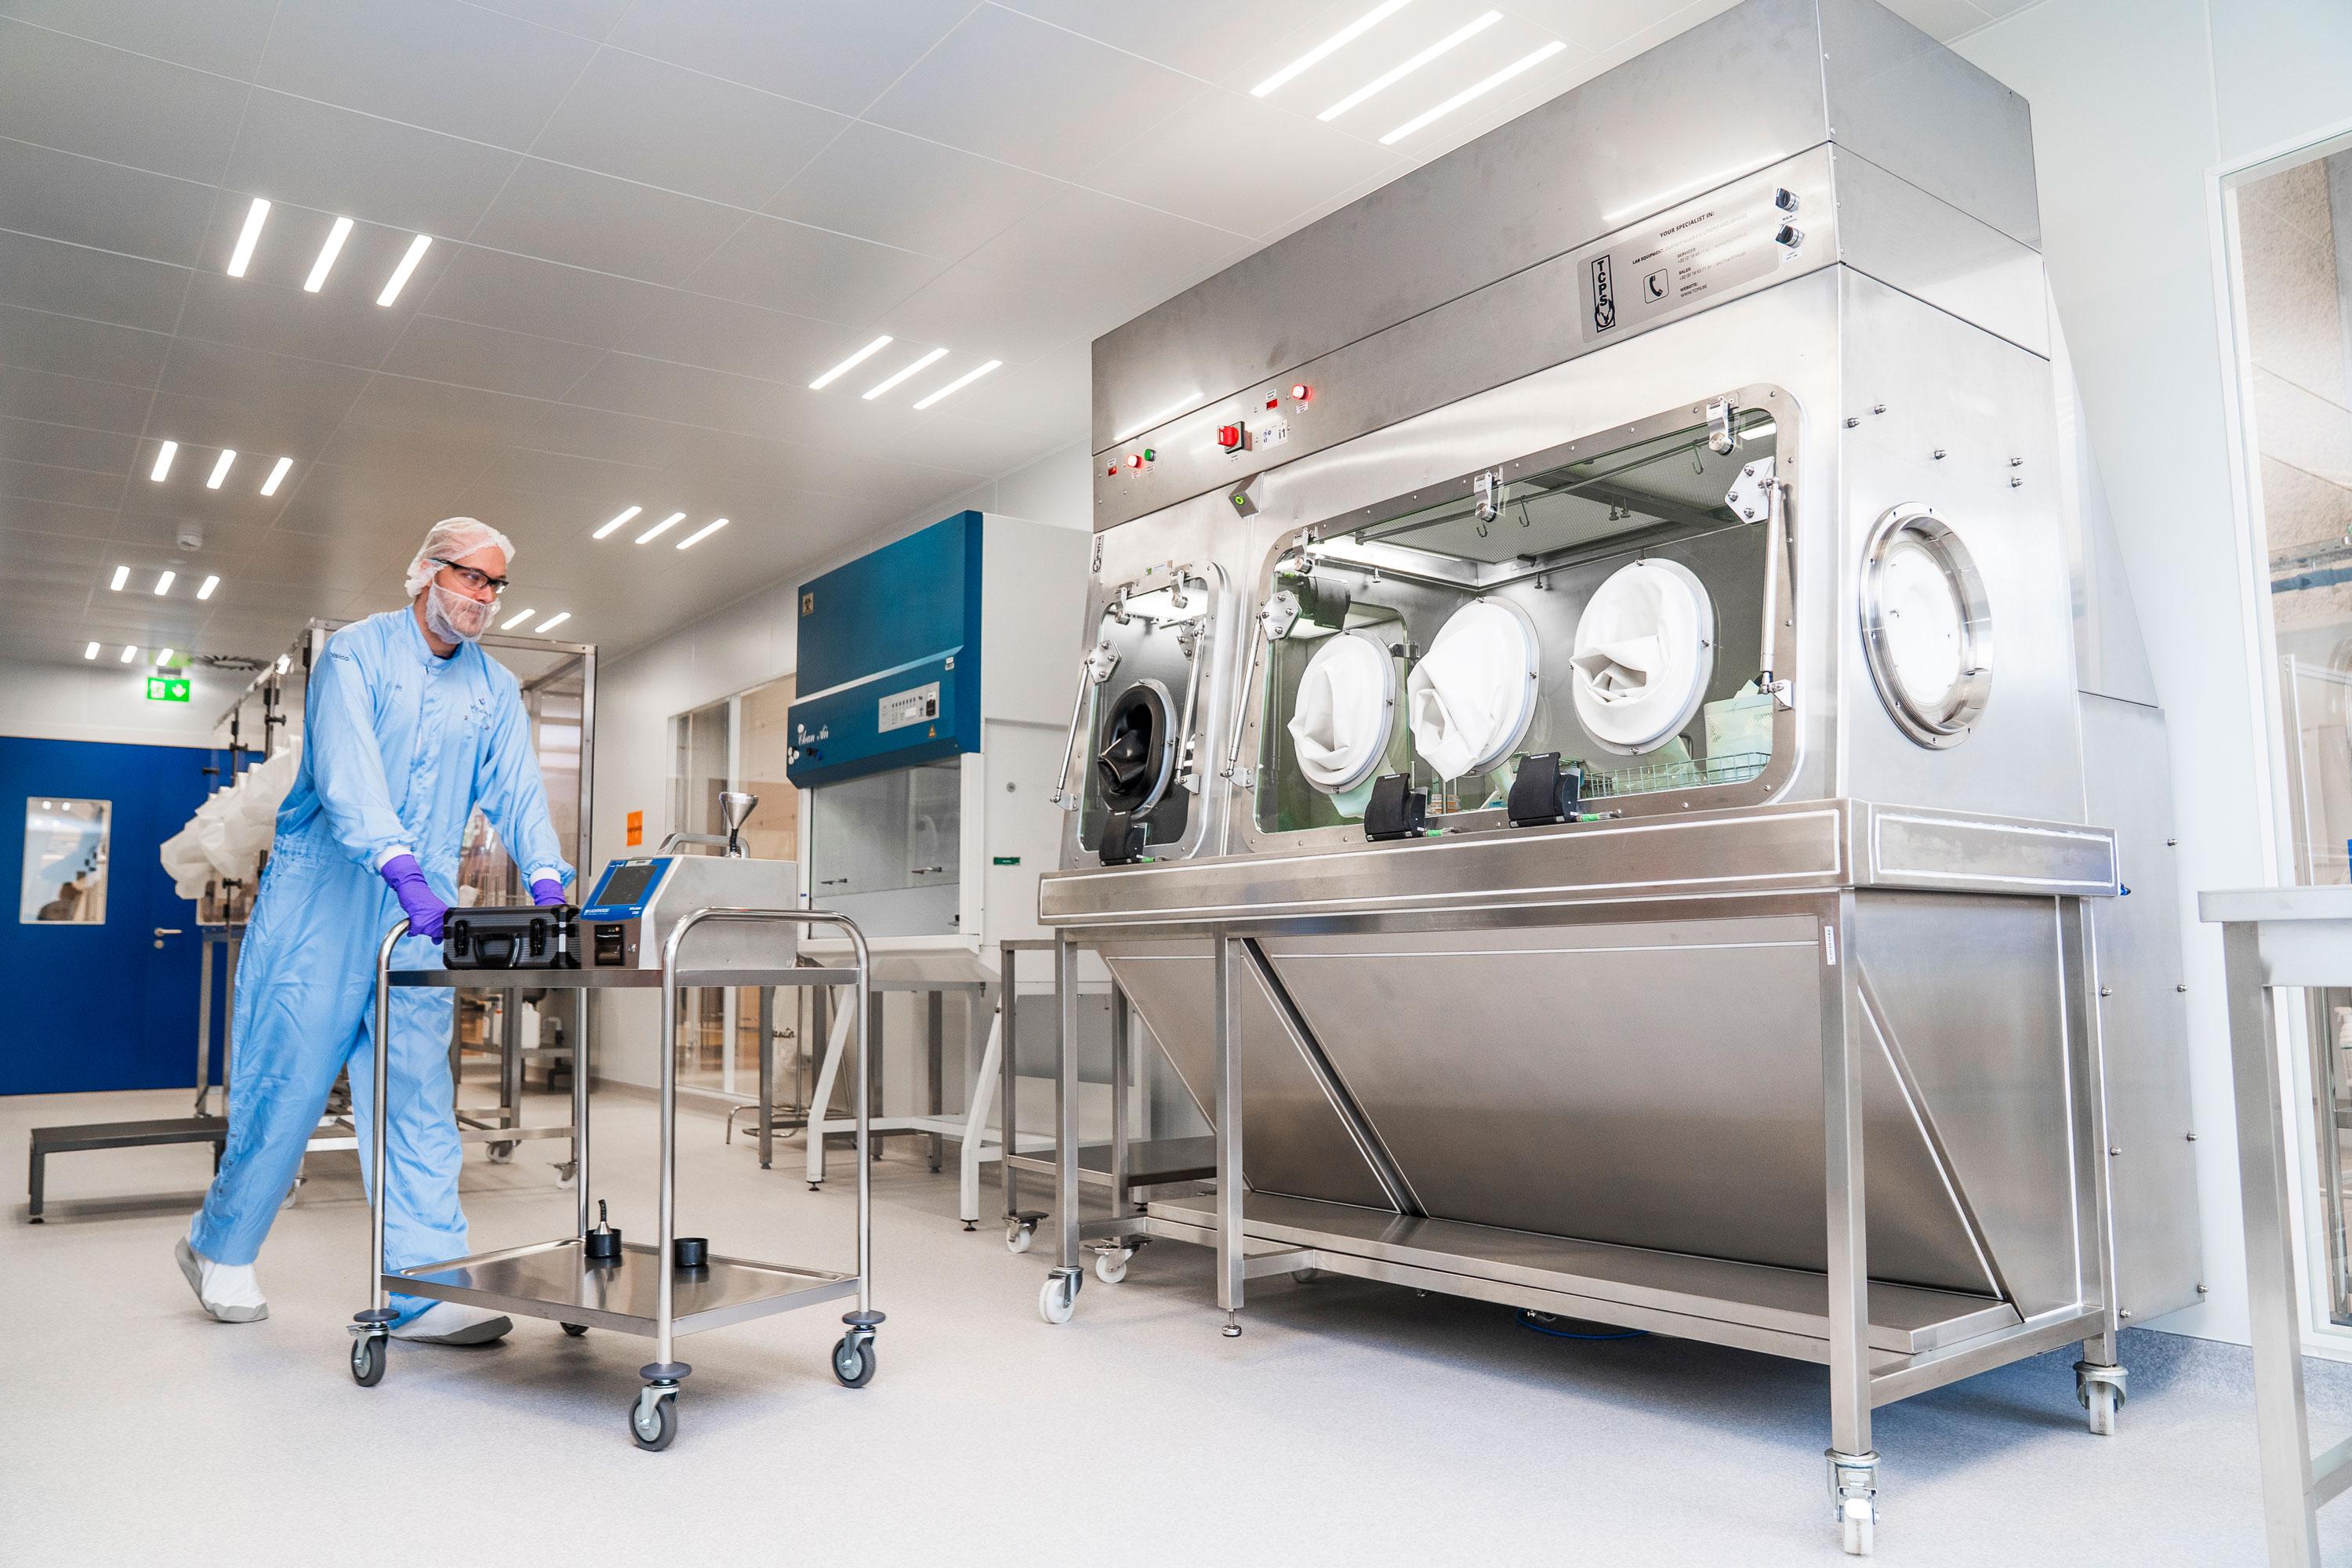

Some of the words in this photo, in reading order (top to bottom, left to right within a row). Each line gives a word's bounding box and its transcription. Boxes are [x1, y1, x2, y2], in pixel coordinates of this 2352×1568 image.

[1660, 228, 1675, 238] YOUR
[1676, 215, 1705, 231] SPECIALIST
[1597, 260, 1608, 307] TCPS
[1679, 282, 1698, 292] WEBSITE:
